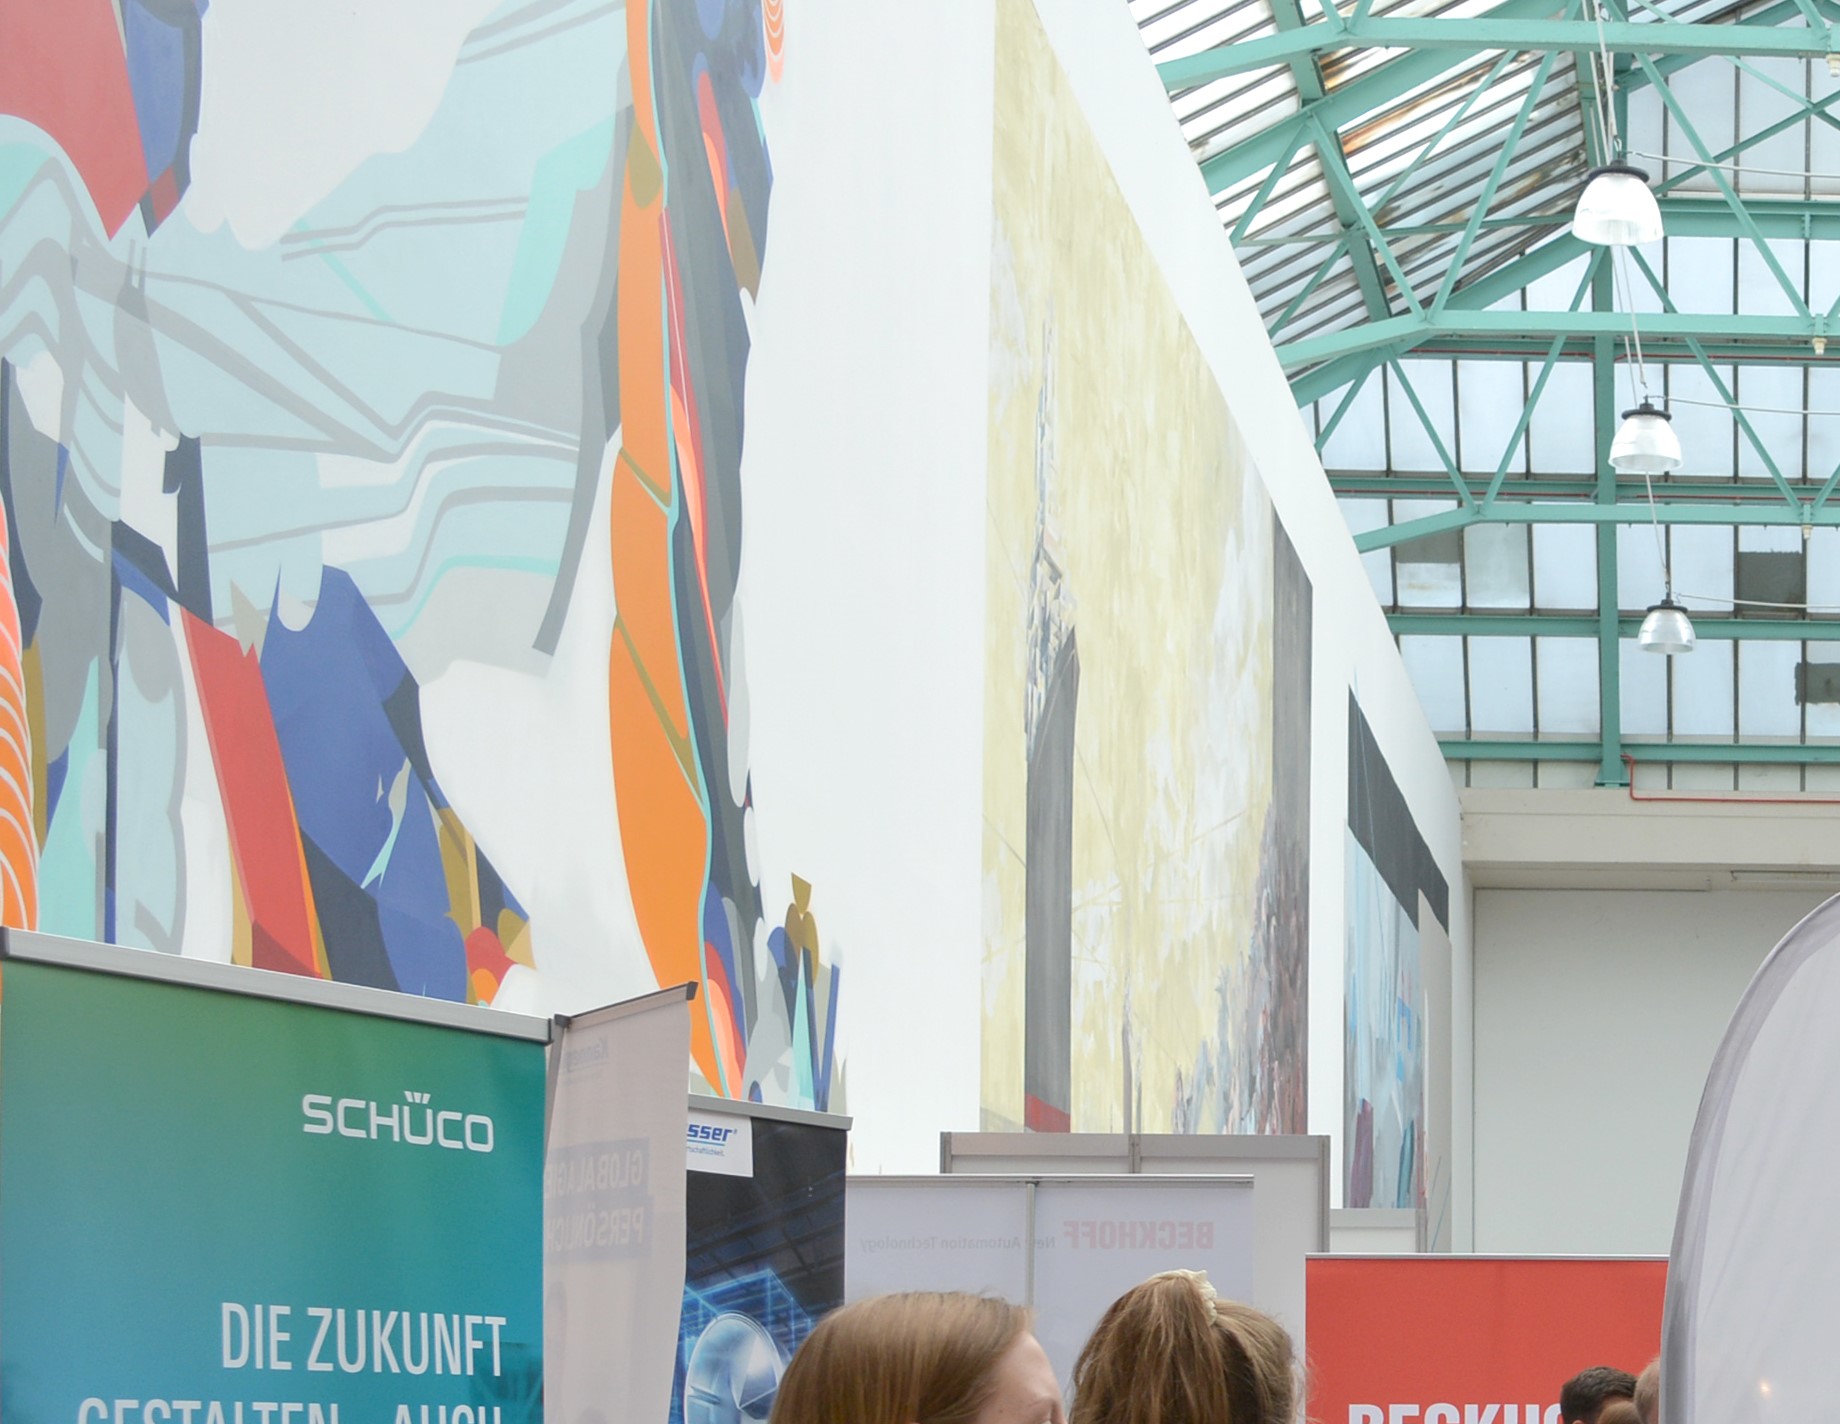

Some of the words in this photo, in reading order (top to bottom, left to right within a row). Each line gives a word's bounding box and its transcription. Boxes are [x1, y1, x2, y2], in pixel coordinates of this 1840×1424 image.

[301, 1091, 494, 1153] SCHÜCO
[221, 1302, 292, 1371] DIE
[306, 1306, 507, 1377] ZUKUNFT
